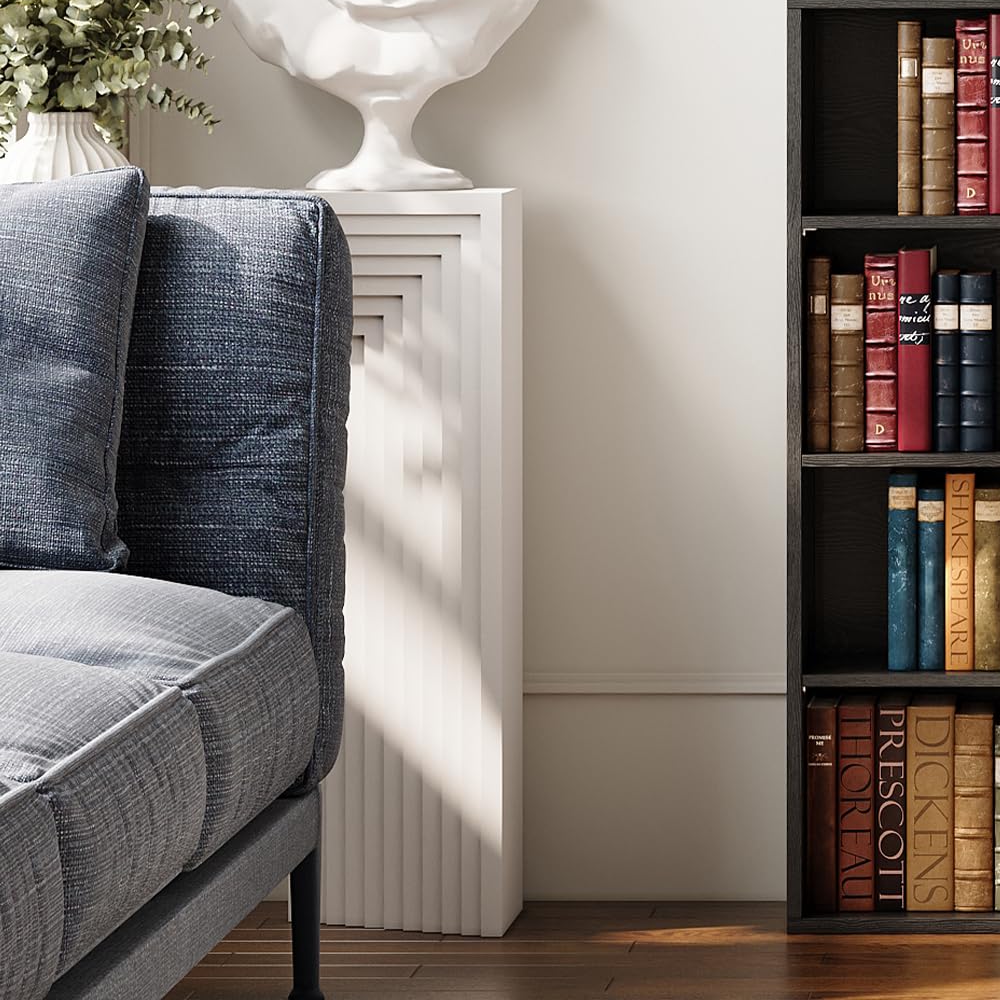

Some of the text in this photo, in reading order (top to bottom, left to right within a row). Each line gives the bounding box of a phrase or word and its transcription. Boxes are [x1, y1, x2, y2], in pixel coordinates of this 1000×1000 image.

[966, 187, 976, 199] D
[875, 424, 885, 435] D
[950, 479, 969, 666] SHAKESPEARE
[840, 716, 873, 899] THOREAU
[877, 709, 905, 909] PRESCOTT
[913, 715, 951, 904] DICKENS
